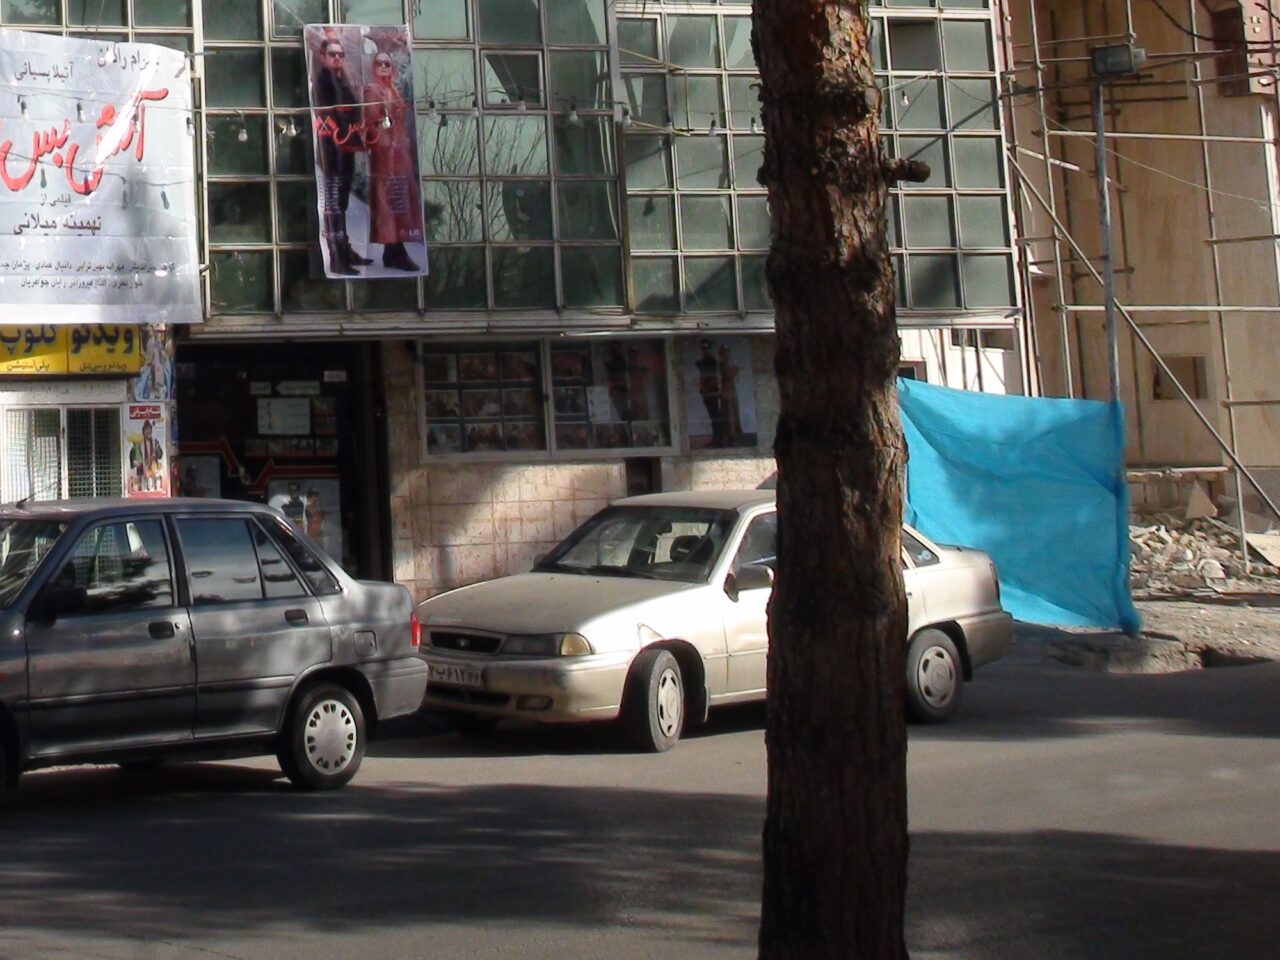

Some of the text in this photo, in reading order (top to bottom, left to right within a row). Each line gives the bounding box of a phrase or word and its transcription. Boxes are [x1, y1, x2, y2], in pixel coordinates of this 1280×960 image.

[97, 46, 160, 72] رام رادن
[52, 61, 75, 83] آتیلا
[40, 193, 47, 206] از
[13, 212, 102, 237] تهمینه میلانی
